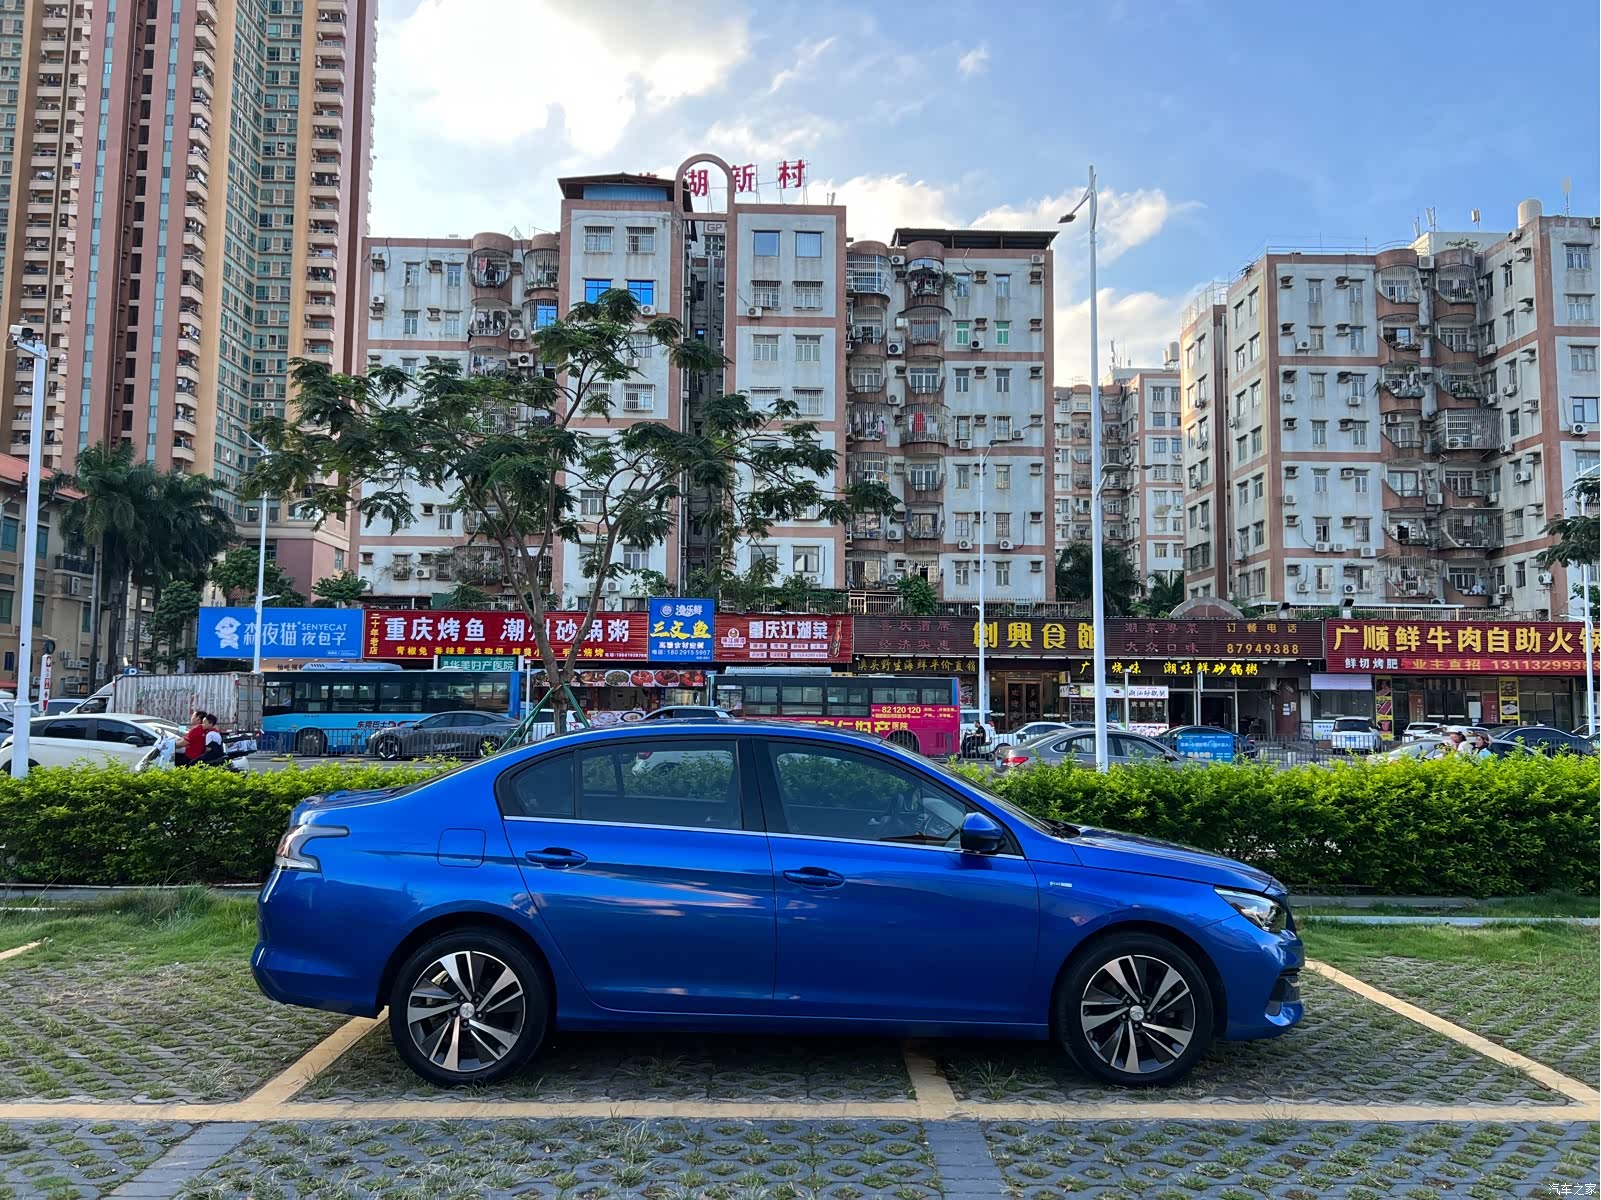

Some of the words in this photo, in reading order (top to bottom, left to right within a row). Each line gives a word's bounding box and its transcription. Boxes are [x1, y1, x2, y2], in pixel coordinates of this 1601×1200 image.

[301, 623, 347, 631] SENYECAT
[385, 617, 486, 642] 重庆烤鱼
[650, 619, 712, 640] 三文鱼
[749, 620, 828, 639] 重庆江湖菜
[881, 620, 951, 631] 喜庆酒席
[1125, 623, 1199, 634] 潮菜粤菜
[1227, 622, 1297, 633] 订餐电话
[302, 632, 346, 646] 夜包子
[369, 613, 380, 655] 二十年老店
[880, 640, 951, 651] 经济实惠
[1125, 641, 1199, 653] 大众口味
[1227, 643, 1299, 654] 87949388
[857, 659, 976, 672] 澳头野生海鲜平价直销
[1079, 660, 1141, 675] 广烧味
[1412, 658, 1481, 671] 业主直招
[881, 706, 892, 714] 82
[893, 706, 906, 714] 120
[907, 706, 921, 714] 120
[357, 720, 388, 728] 东莞巴士
